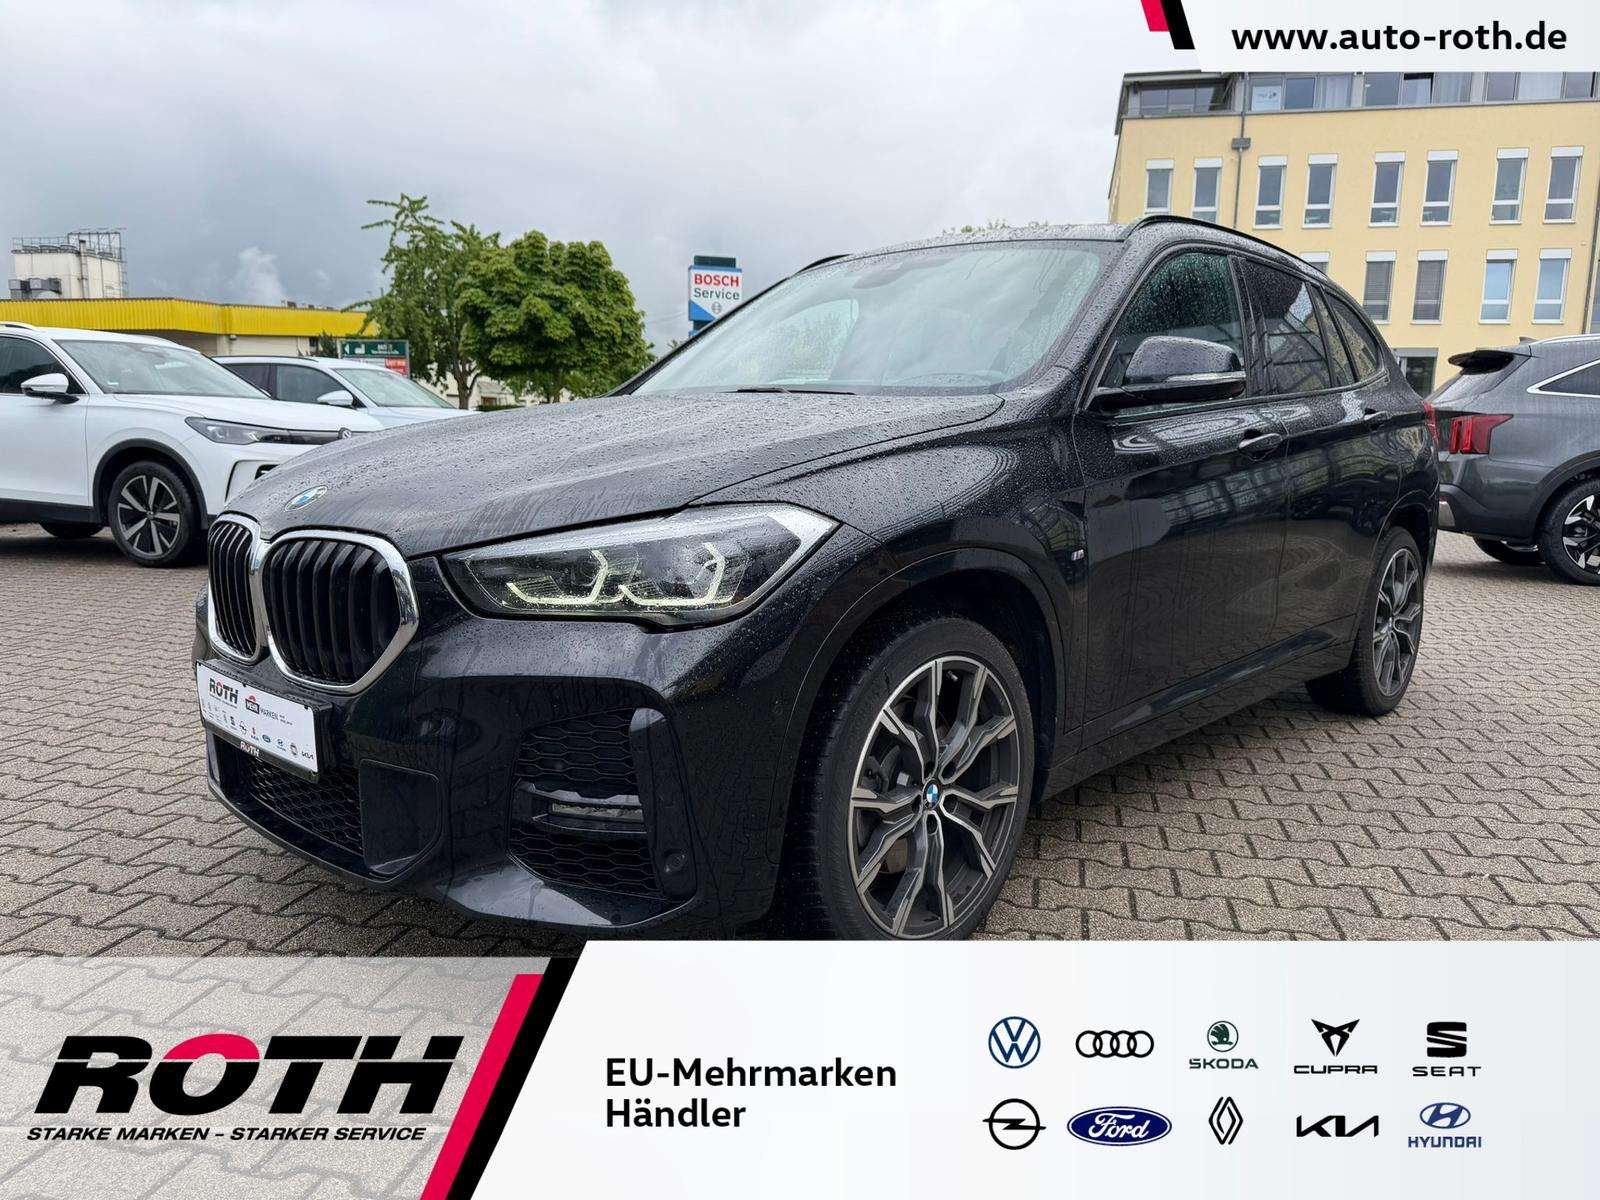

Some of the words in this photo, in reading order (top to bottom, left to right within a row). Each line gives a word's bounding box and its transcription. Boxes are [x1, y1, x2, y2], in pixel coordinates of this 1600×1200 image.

[694, 273, 739, 287] BOSCH
[693, 287, 740, 300] Service
[209, 677, 239, 704] ROTH
[240, 741, 260, 757] ROTH
